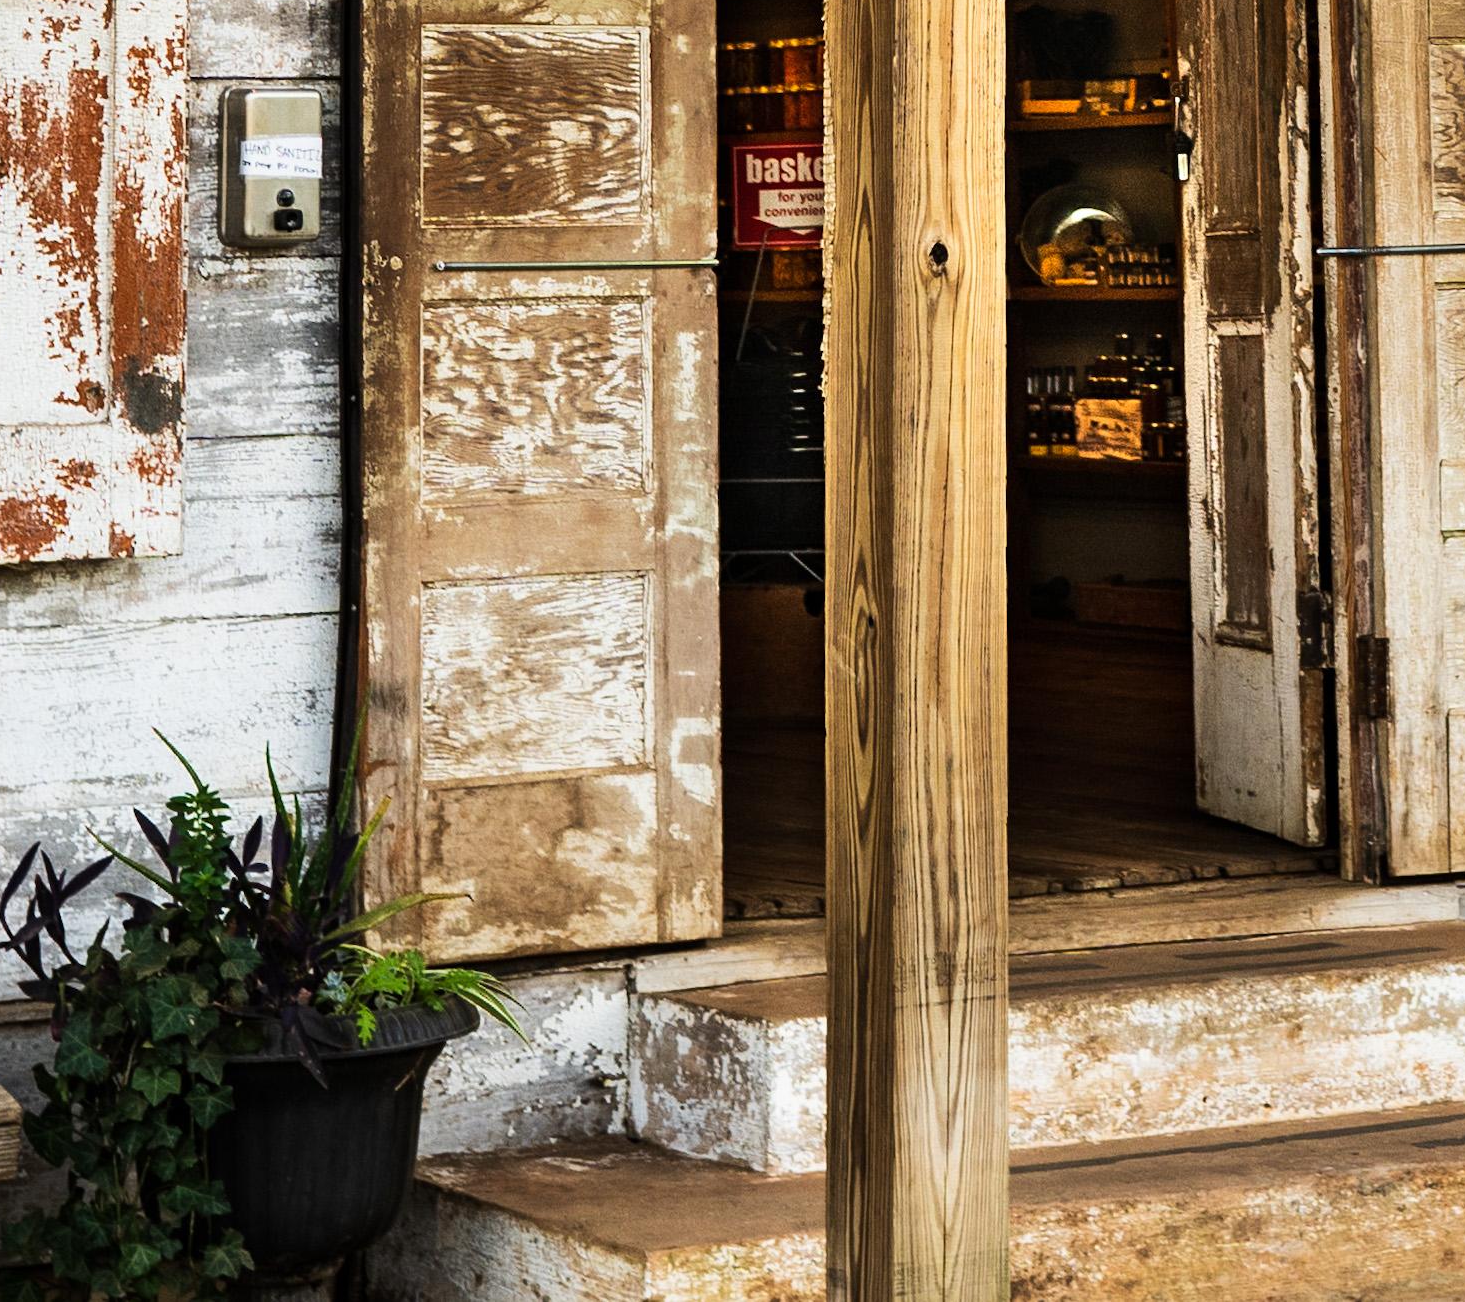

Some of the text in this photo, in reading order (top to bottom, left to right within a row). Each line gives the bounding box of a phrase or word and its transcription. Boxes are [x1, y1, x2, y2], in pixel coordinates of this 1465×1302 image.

[244, 141, 271, 156] HAND
[777, 192, 825, 204] for you
